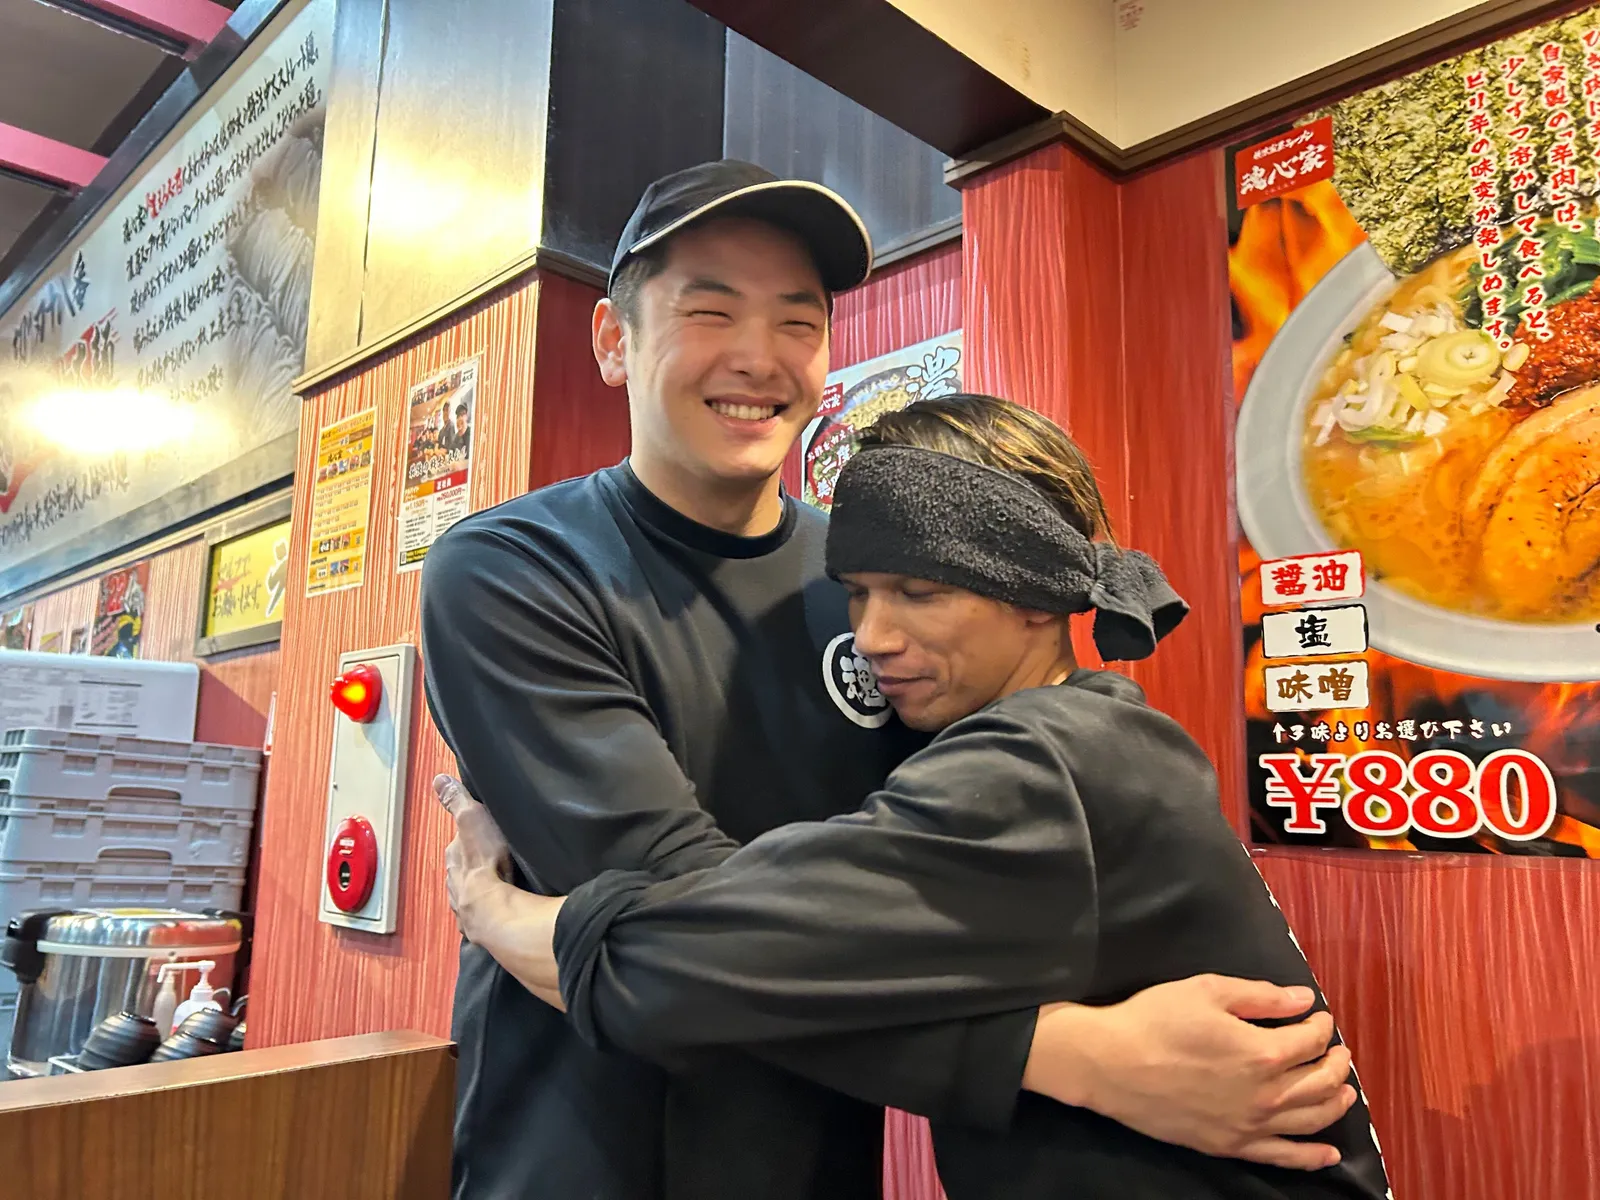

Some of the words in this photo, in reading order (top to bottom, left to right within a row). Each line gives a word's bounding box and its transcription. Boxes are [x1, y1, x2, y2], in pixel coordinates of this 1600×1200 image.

[1542, 43, 1582, 230] 自家製の「辛肉」は、
[1241, 144, 1328, 194] 魂心家
[1271, 560, 1349, 596] 醤油
[1295, 614, 1332, 650] 塩
[1277, 667, 1355, 703] 味噌
[1259, 749, 1557, 841] ¥880
